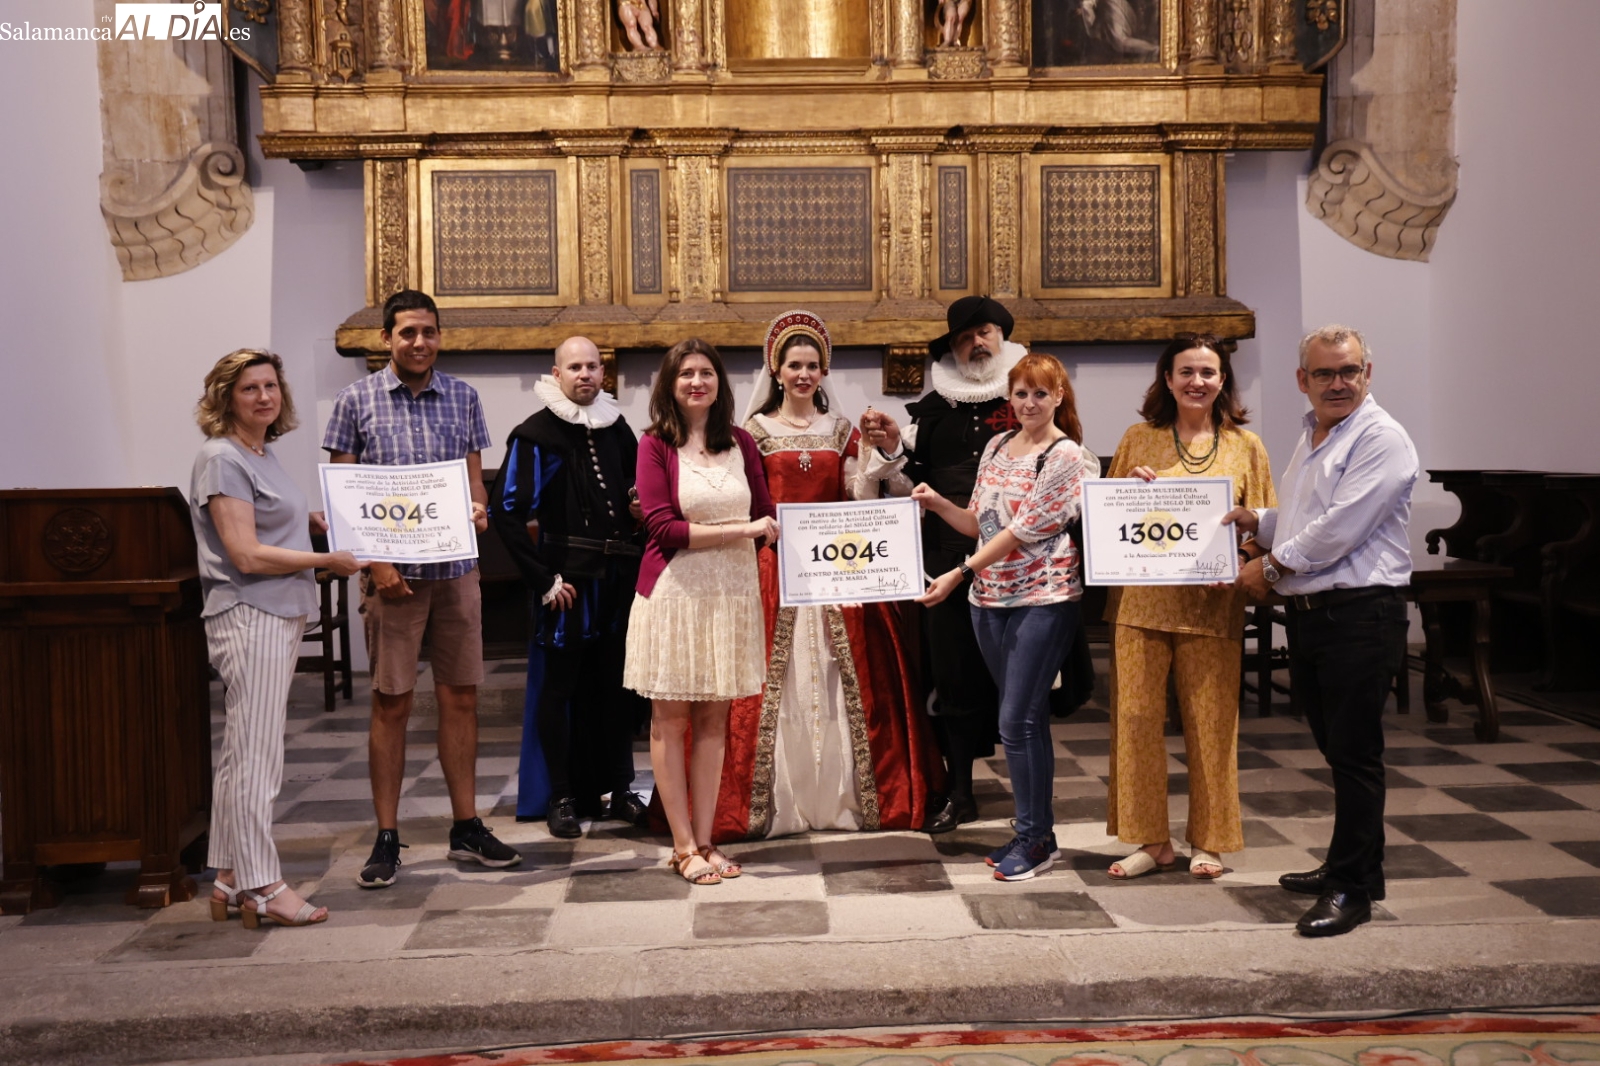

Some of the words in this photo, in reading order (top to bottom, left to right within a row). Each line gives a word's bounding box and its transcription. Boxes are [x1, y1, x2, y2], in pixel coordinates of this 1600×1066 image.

[360, 502, 438, 524] 1004€
[843, 508, 886, 516] MULTIMEDIA
[845, 515, 872, 523] Actividad
[873, 513, 897, 521] Cultural
[404, 525, 451, 533] SALMANTINA
[1118, 522, 1199, 545] 1300€
[376, 537, 430, 545] CIBERBULLYING
[811, 540, 889, 563] 1004€
[867, 566, 901, 574] INFANTIL
